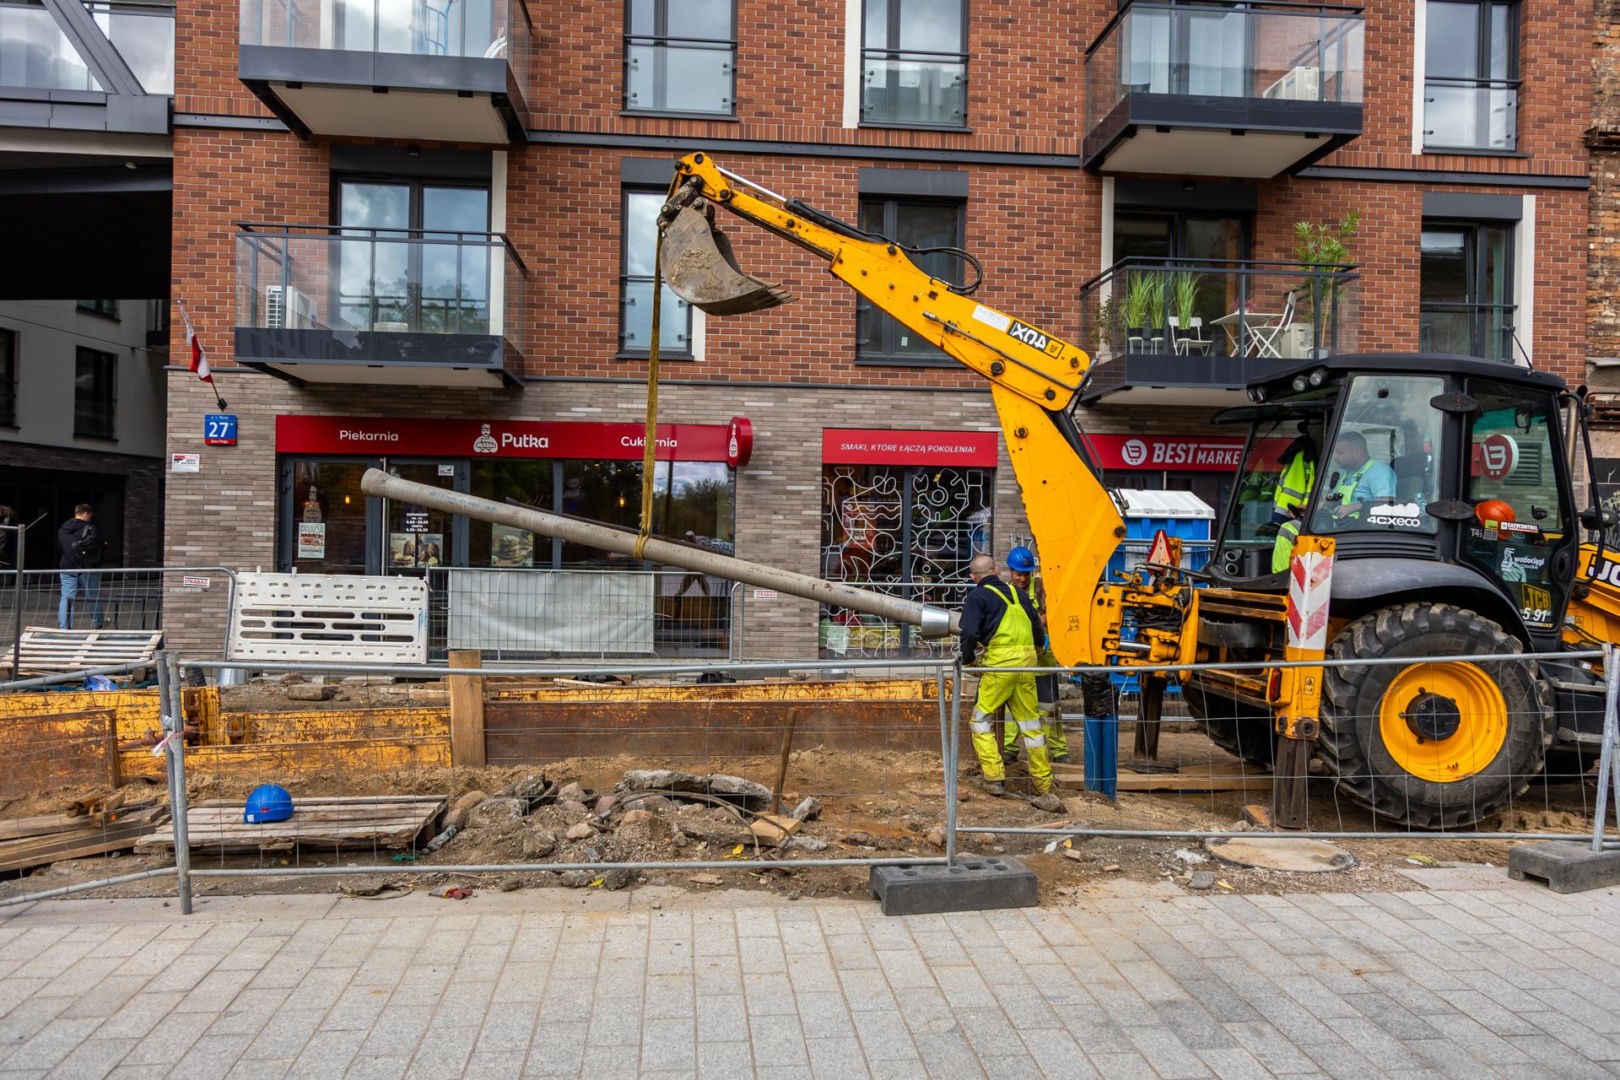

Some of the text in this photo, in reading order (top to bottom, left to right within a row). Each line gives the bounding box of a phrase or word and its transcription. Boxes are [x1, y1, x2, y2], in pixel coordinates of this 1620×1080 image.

[209, 421, 229, 438] 27
[339, 429, 399, 442] Piekarnia
[501, 432, 549, 449] Putka
[620, 436, 678, 448] Cukirnia
[840, 443, 976, 454] SMAKI, KTÓRE ŁĄCZĄ POKOLENIA!
[1152, 442, 1241, 465] BEST MARKE
[1366, 515, 1421, 527] 4CXeco
[1525, 587, 1550, 610] JCB
[1522, 607, 1548, 622] 5 91
